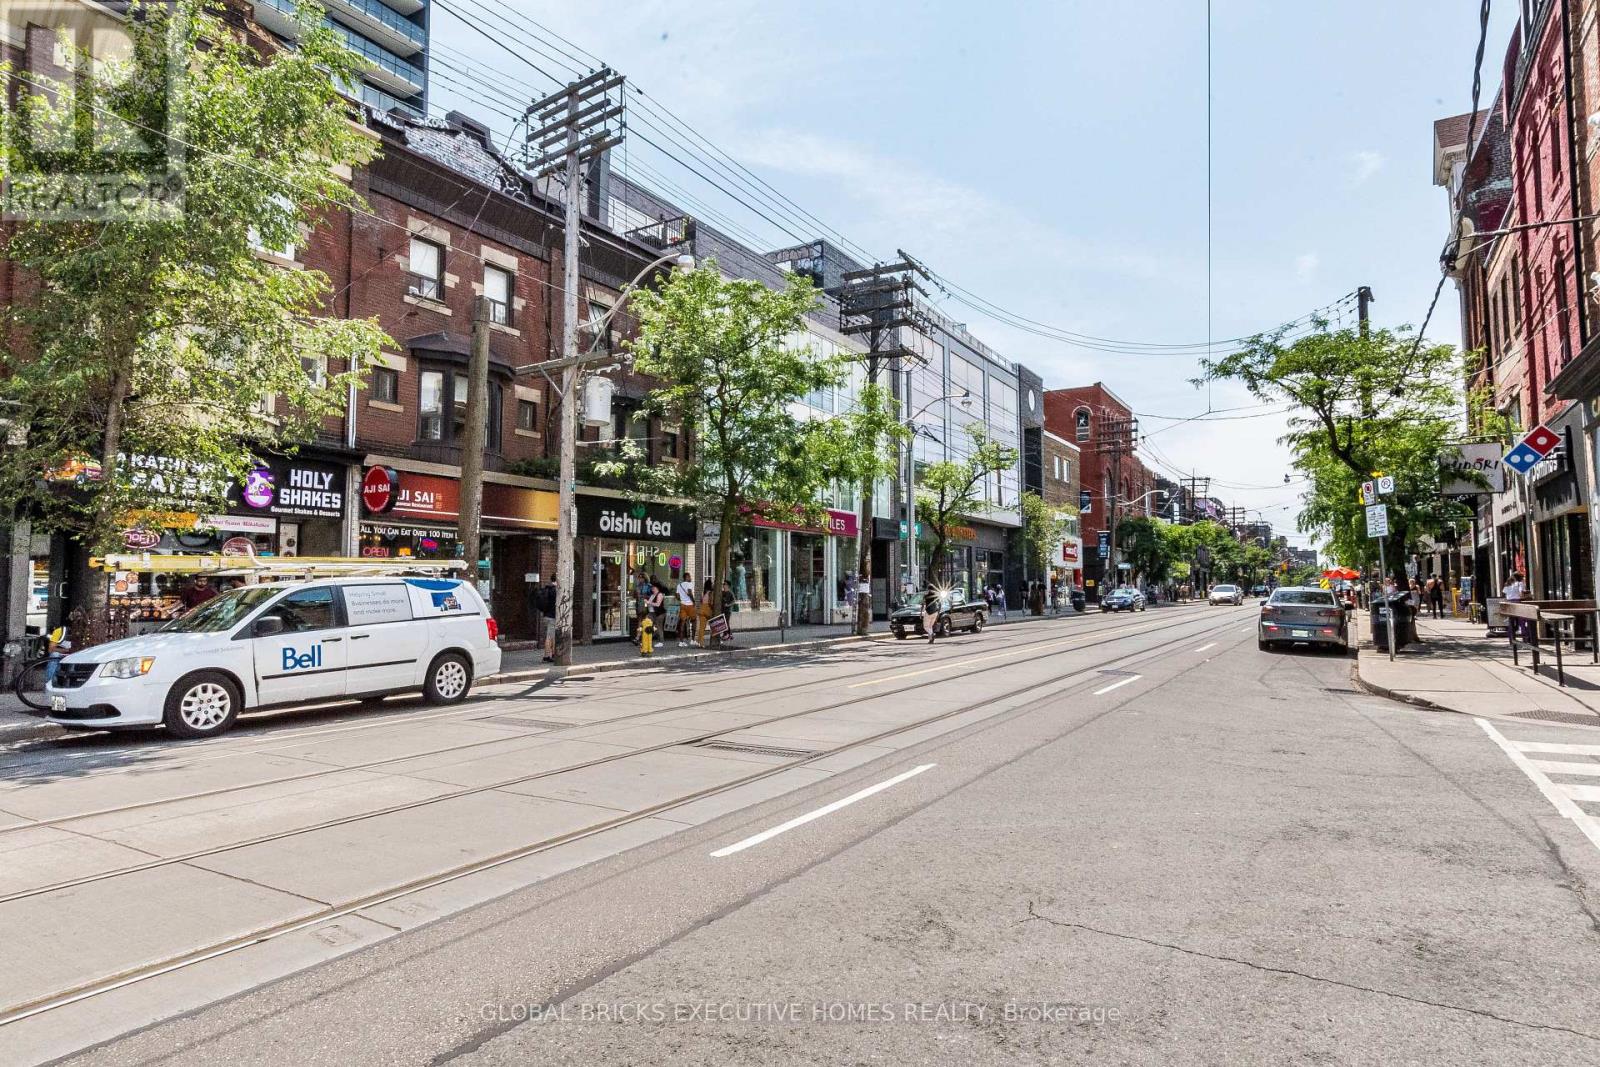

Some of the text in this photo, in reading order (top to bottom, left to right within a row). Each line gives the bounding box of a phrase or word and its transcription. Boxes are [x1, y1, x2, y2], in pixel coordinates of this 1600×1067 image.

[290, 468, 333, 490] HOLY
[363, 483, 390, 494] AJI SAI
[279, 488, 342, 509] SHAKES
[397, 489, 410, 501] JI
[414, 491, 434, 503] SAI
[645, 516, 671, 537] tea
[362, 547, 390, 557] OPEN
[282, 644, 322, 671] Bell
